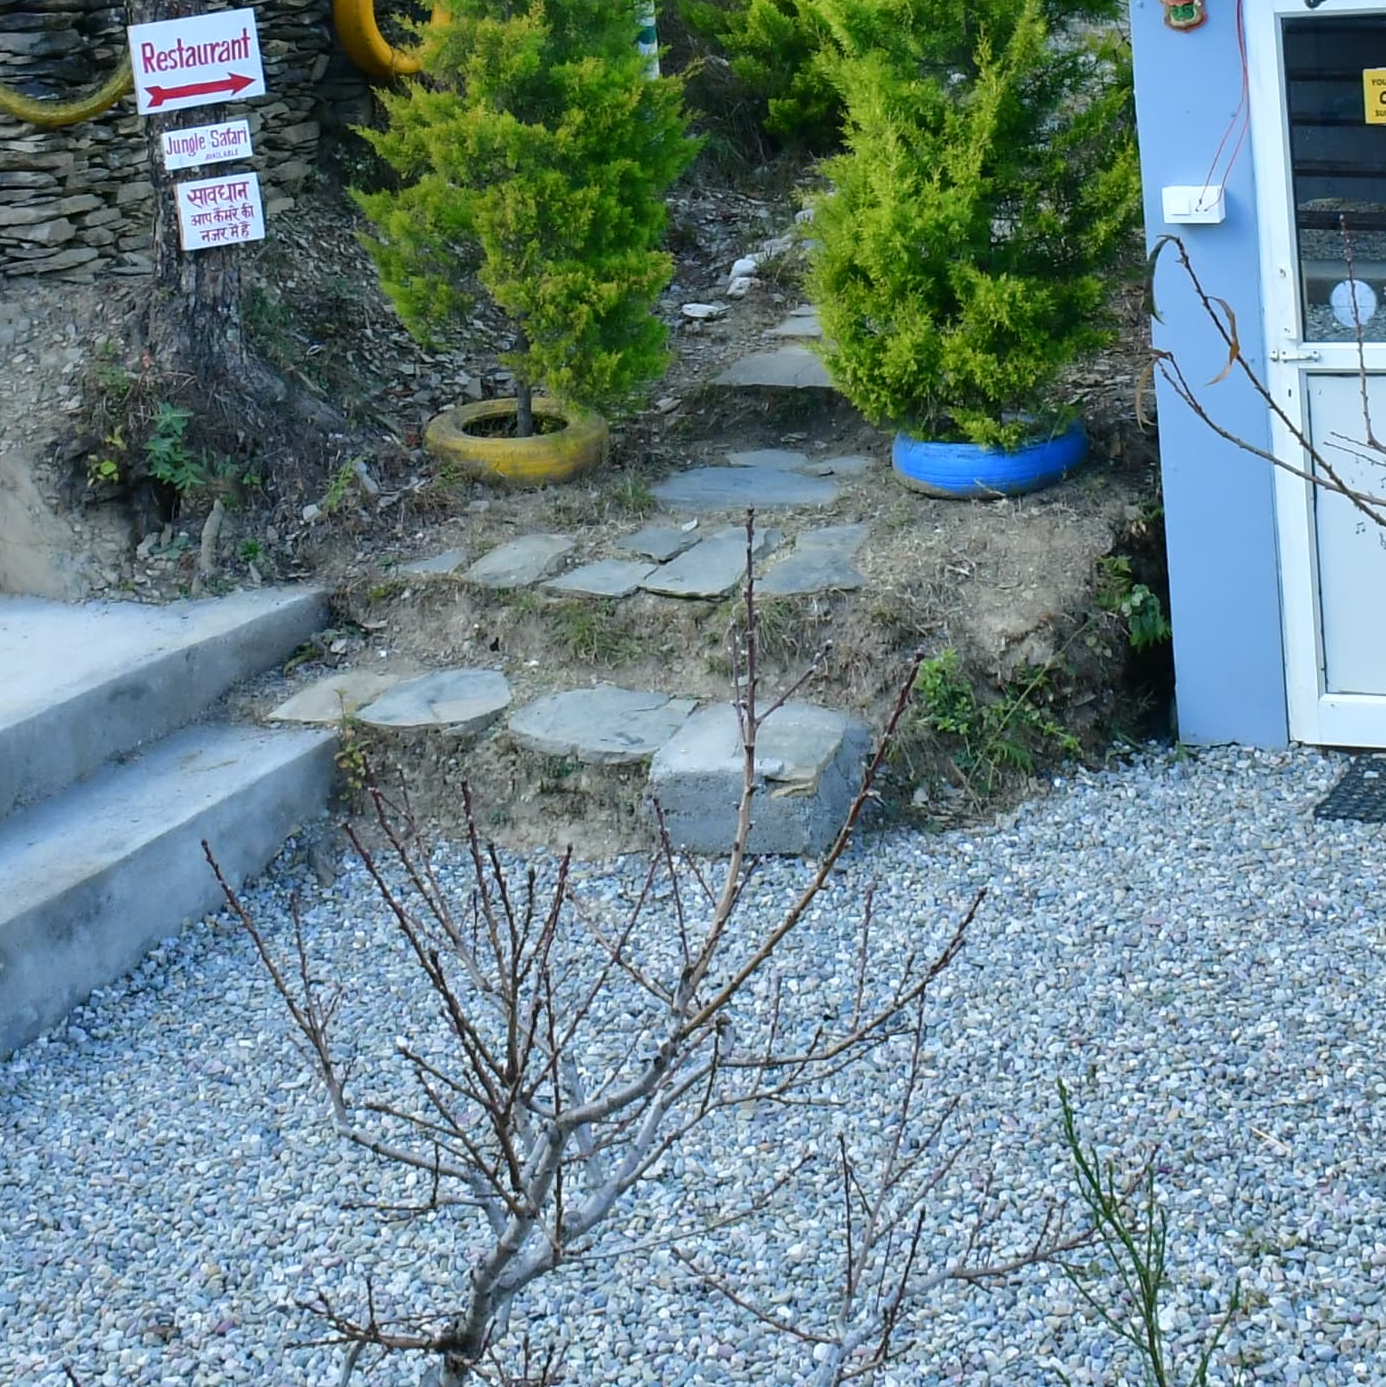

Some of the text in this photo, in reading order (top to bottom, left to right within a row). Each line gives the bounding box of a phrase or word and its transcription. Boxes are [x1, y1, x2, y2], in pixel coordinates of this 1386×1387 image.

[141, 27, 251, 75] Restaurant
[166, 126, 248, 157] Jungle Safari
[187, 181, 250, 209] सावधान
